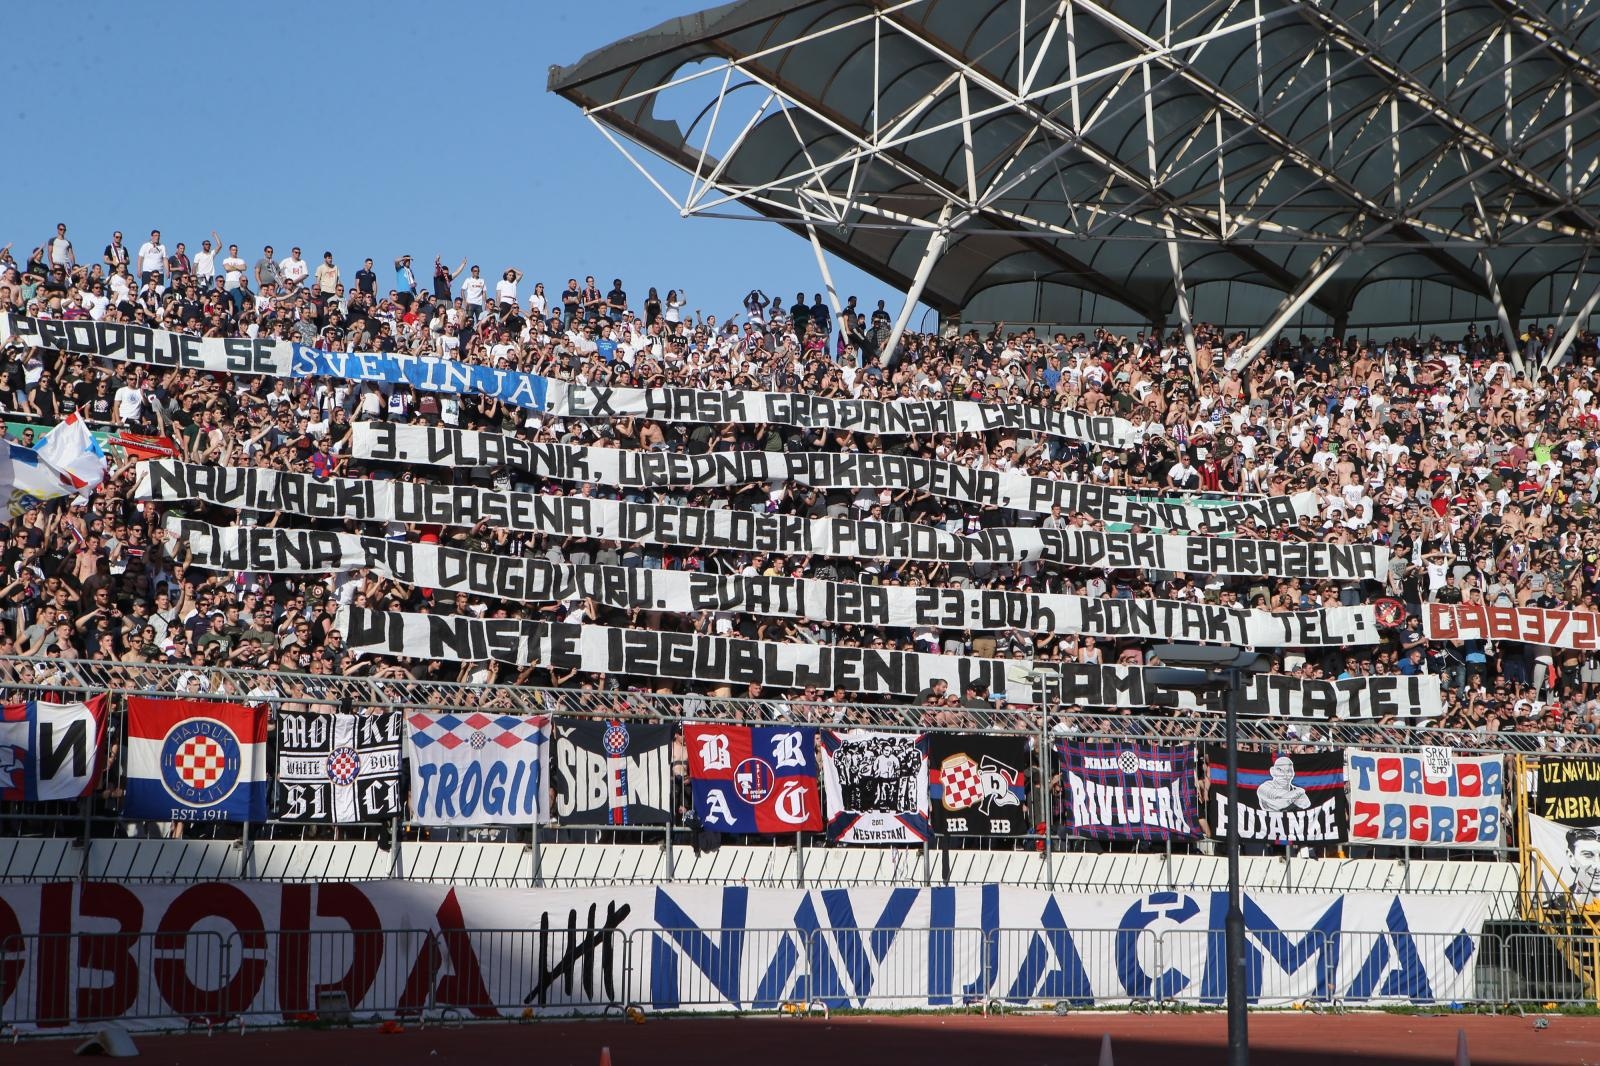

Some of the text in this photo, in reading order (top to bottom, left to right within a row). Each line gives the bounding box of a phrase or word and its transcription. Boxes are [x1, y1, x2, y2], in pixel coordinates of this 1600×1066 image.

[9, 314, 206, 368] PRODAJE
[223, 338, 278, 372] SE
[645, 388, 747, 422] HASK
[370, 422, 408, 460] 3.
[427, 427, 603, 483] VLASNIK,
[618, 450, 769, 486] UREDNO
[786, 452, 1011, 507] POKRADENA,
[1200, 496, 1297, 533] CRNA
[394, 482, 604, 537] UGASENA,
[618, 502, 812, 552] IDEOLOŠKI
[832, 519, 1028, 561] POKOJNA,
[1039, 528, 1165, 568] SUDSKI
[180, 520, 342, 570] CIJENA
[360, 537, 413, 582] PO
[438, 547, 666, 608] DOGOVORU.
[690, 572, 804, 616] ZVATI
[826, 581, 889, 624] IZA
[915, 588, 1055, 631] 23:00h
[1081, 598, 1251, 645] KONTAKT
[1430, 604, 1600, 649] 098372
[347, 606, 404, 652] VI
[428, 614, 581, 669] NISTE
[1206, 674, 1421, 717] UTATE!
[171, 722, 232, 747] HAJDUK
[287, 760, 320, 775] WHITE
[1543, 762, 1561, 783] UZ
[173, 781, 225, 802] SPLIT
[705, 789, 737, 825] A
[1069, 770, 1190, 834] RIVIJERA
[171, 808, 228, 821] EST. 1911
[853, 826, 906, 840] NESVRSTANI
[946, 817, 1011, 833] HR HB
[1352, 801, 1499, 844] ZAGREB
[0, 881, 503, 1028] BODA
